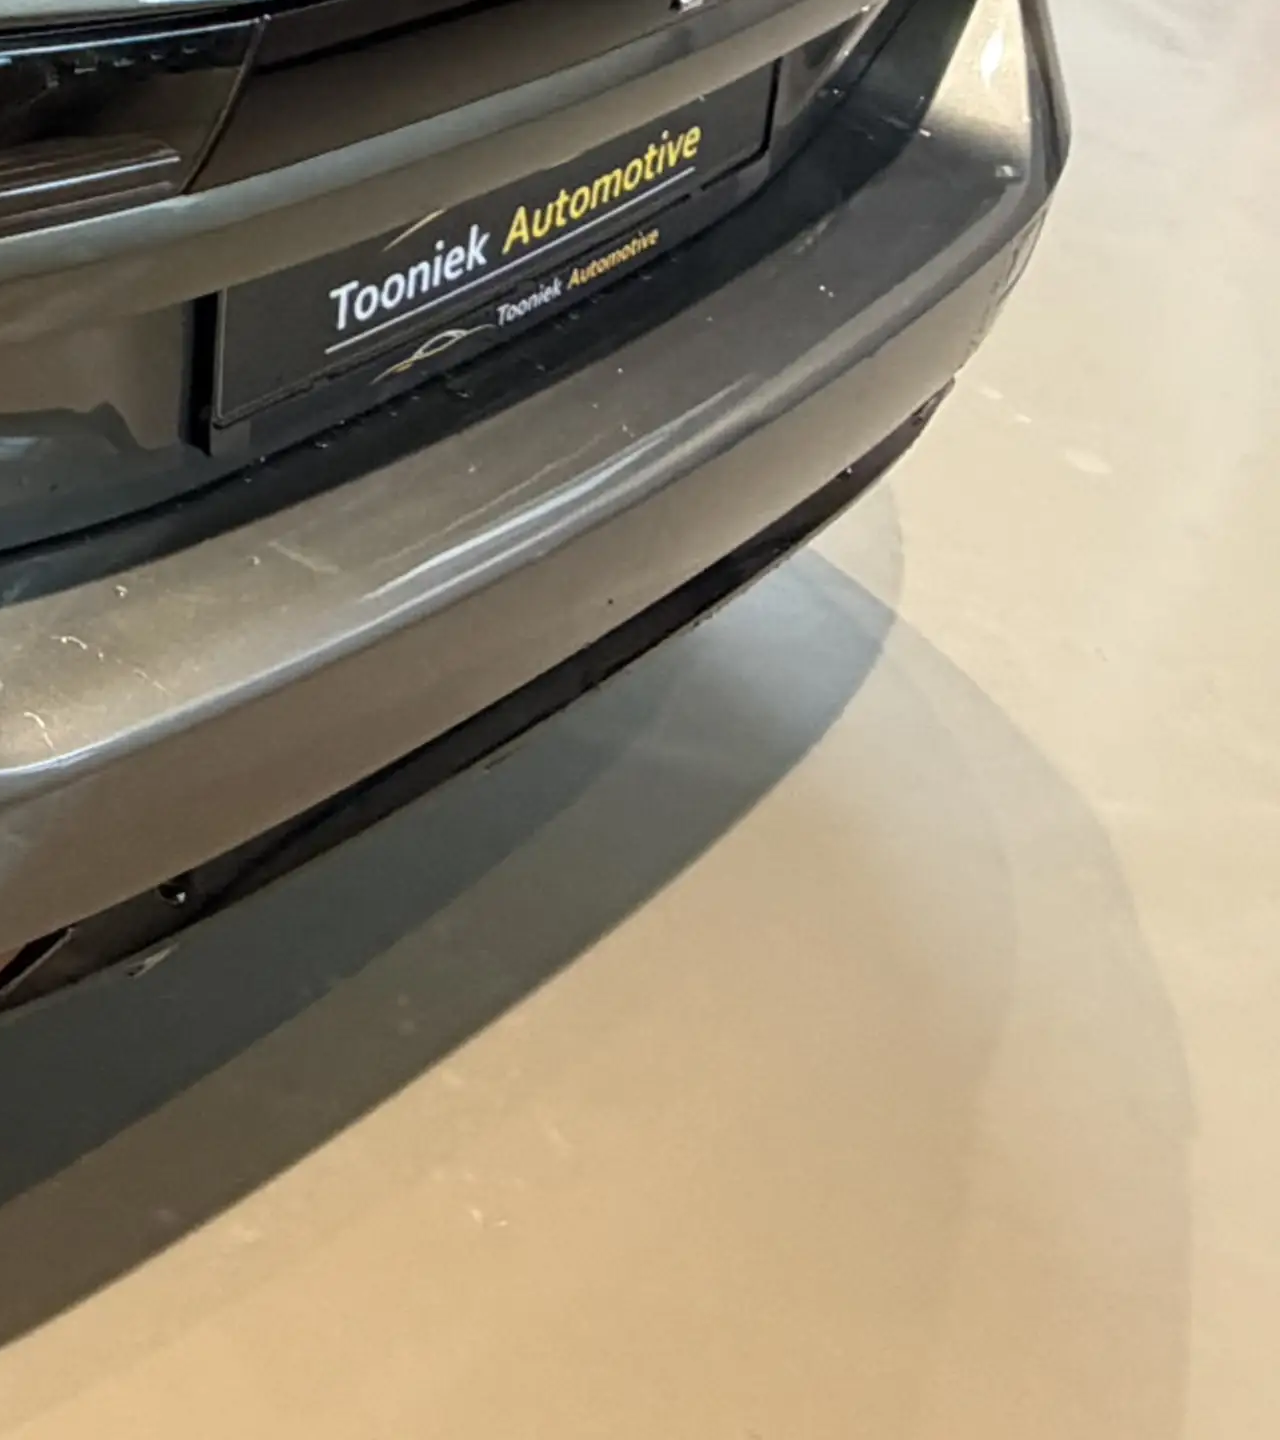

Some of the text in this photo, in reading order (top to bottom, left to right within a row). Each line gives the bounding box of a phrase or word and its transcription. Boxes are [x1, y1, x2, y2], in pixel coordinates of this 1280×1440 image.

[328, 124, 701, 331] Tooniek Automotive
[495, 227, 660, 327] Tooniek Automotive
